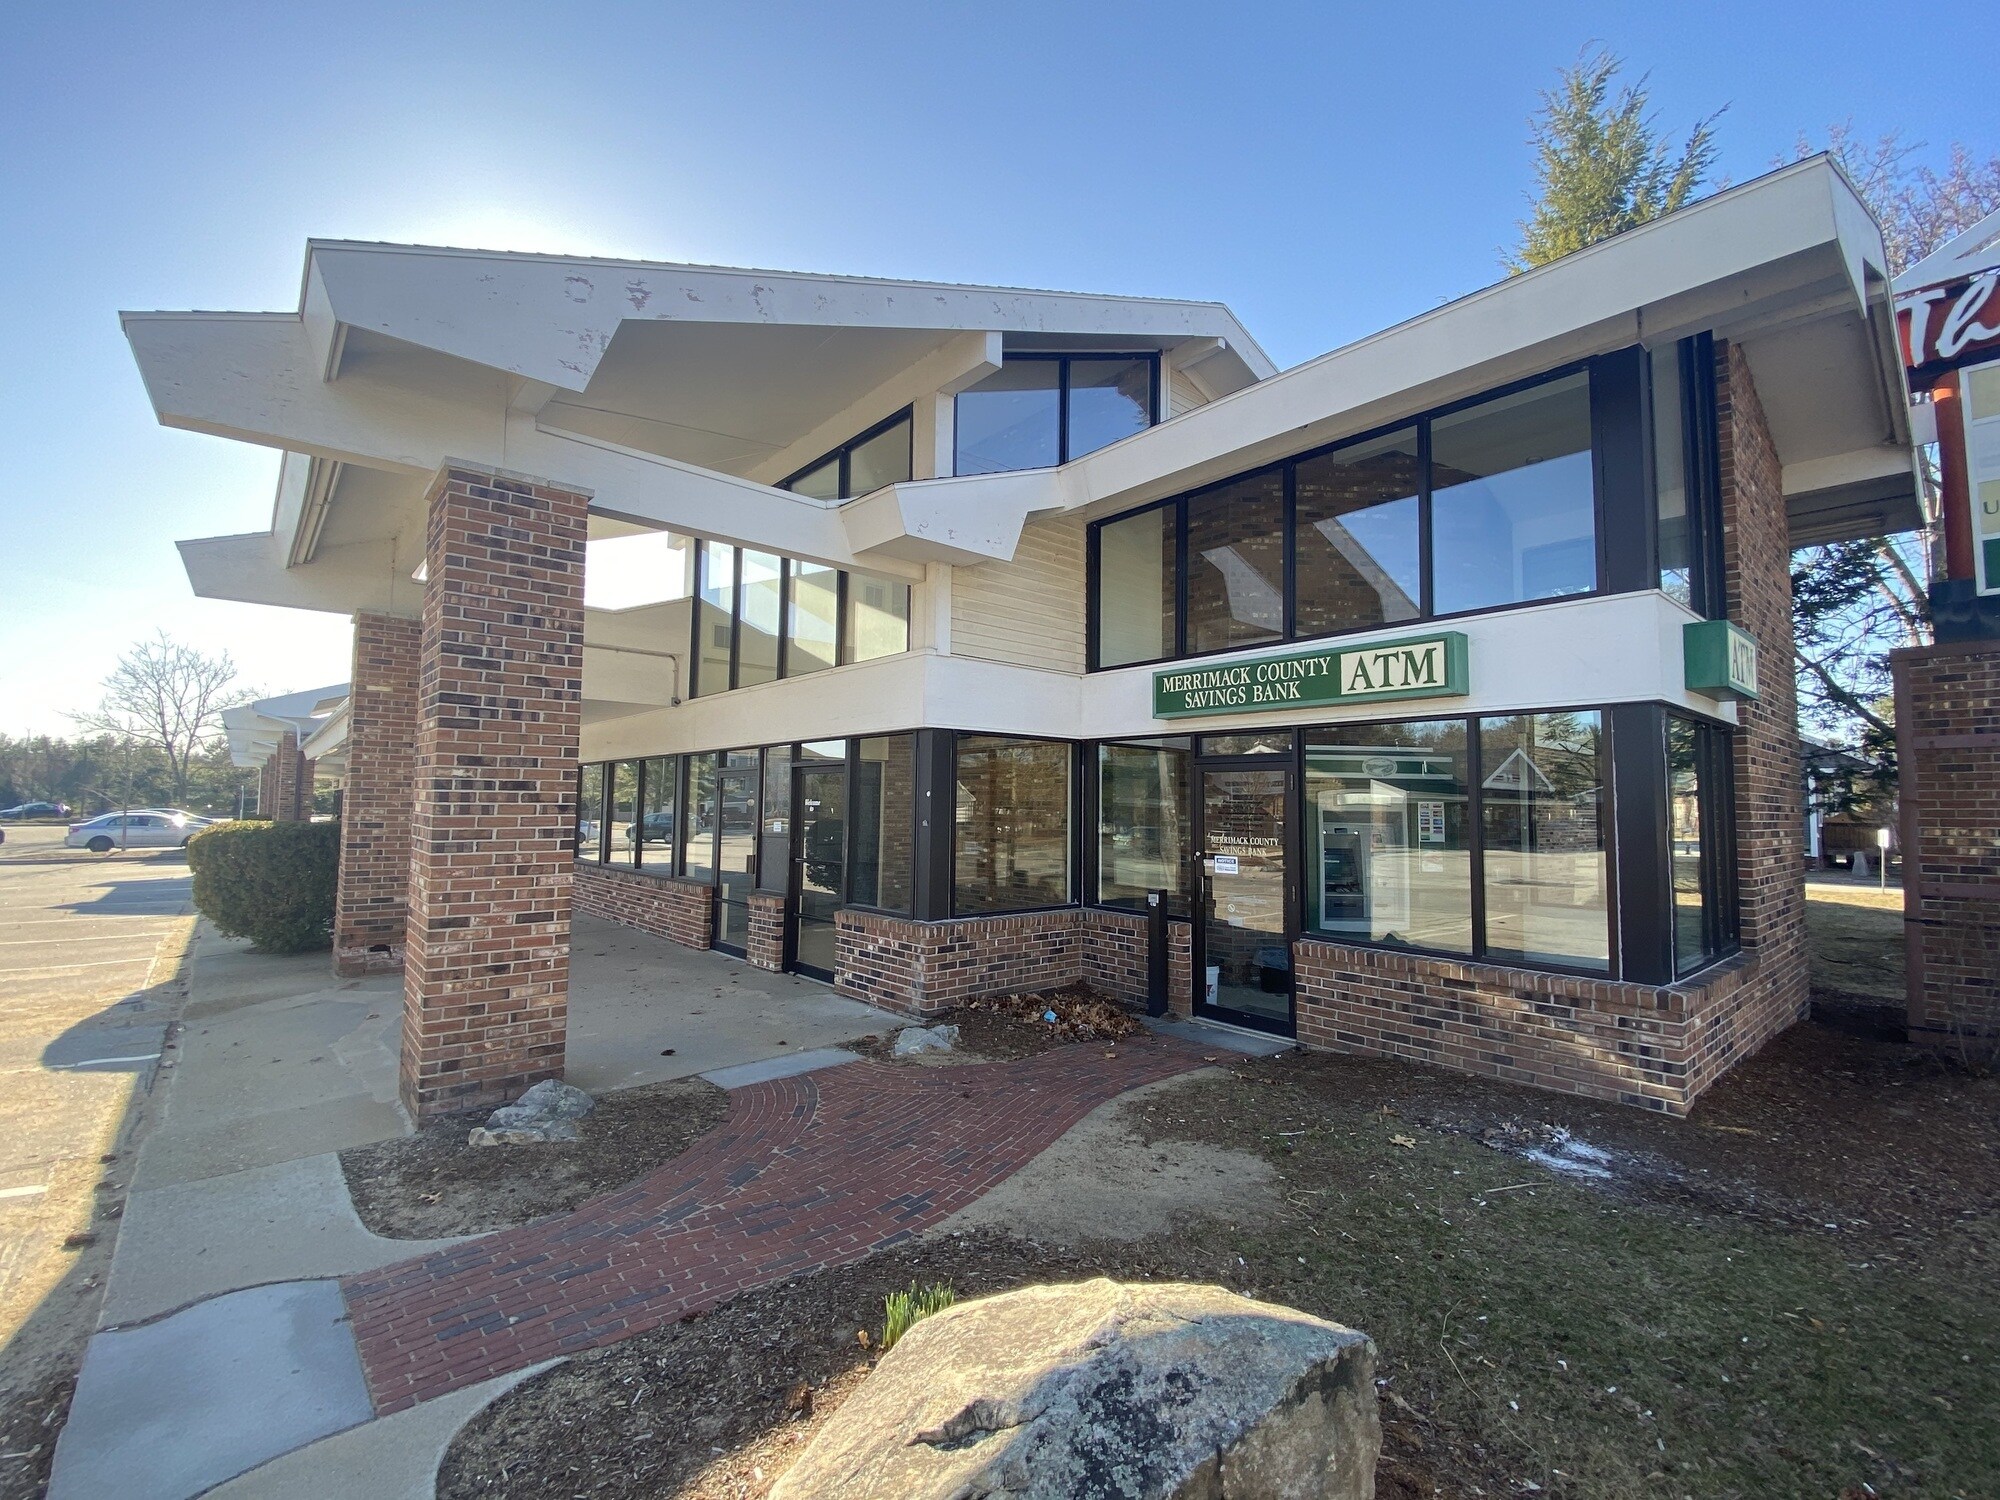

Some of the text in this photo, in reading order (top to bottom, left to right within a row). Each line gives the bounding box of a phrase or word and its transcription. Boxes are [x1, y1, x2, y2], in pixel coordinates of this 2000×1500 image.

[1162, 656, 1332, 693] MERRIMACK COUNTY
[1347, 647, 1438, 691] ATM
[1731, 636, 1755, 688] ATM
[1184, 680, 1301, 709] SAVINGS BANK
[1211, 835, 1279, 846] MERRIMACK COUNTY
[1220, 845, 1267, 856] SAVINGS BANK
